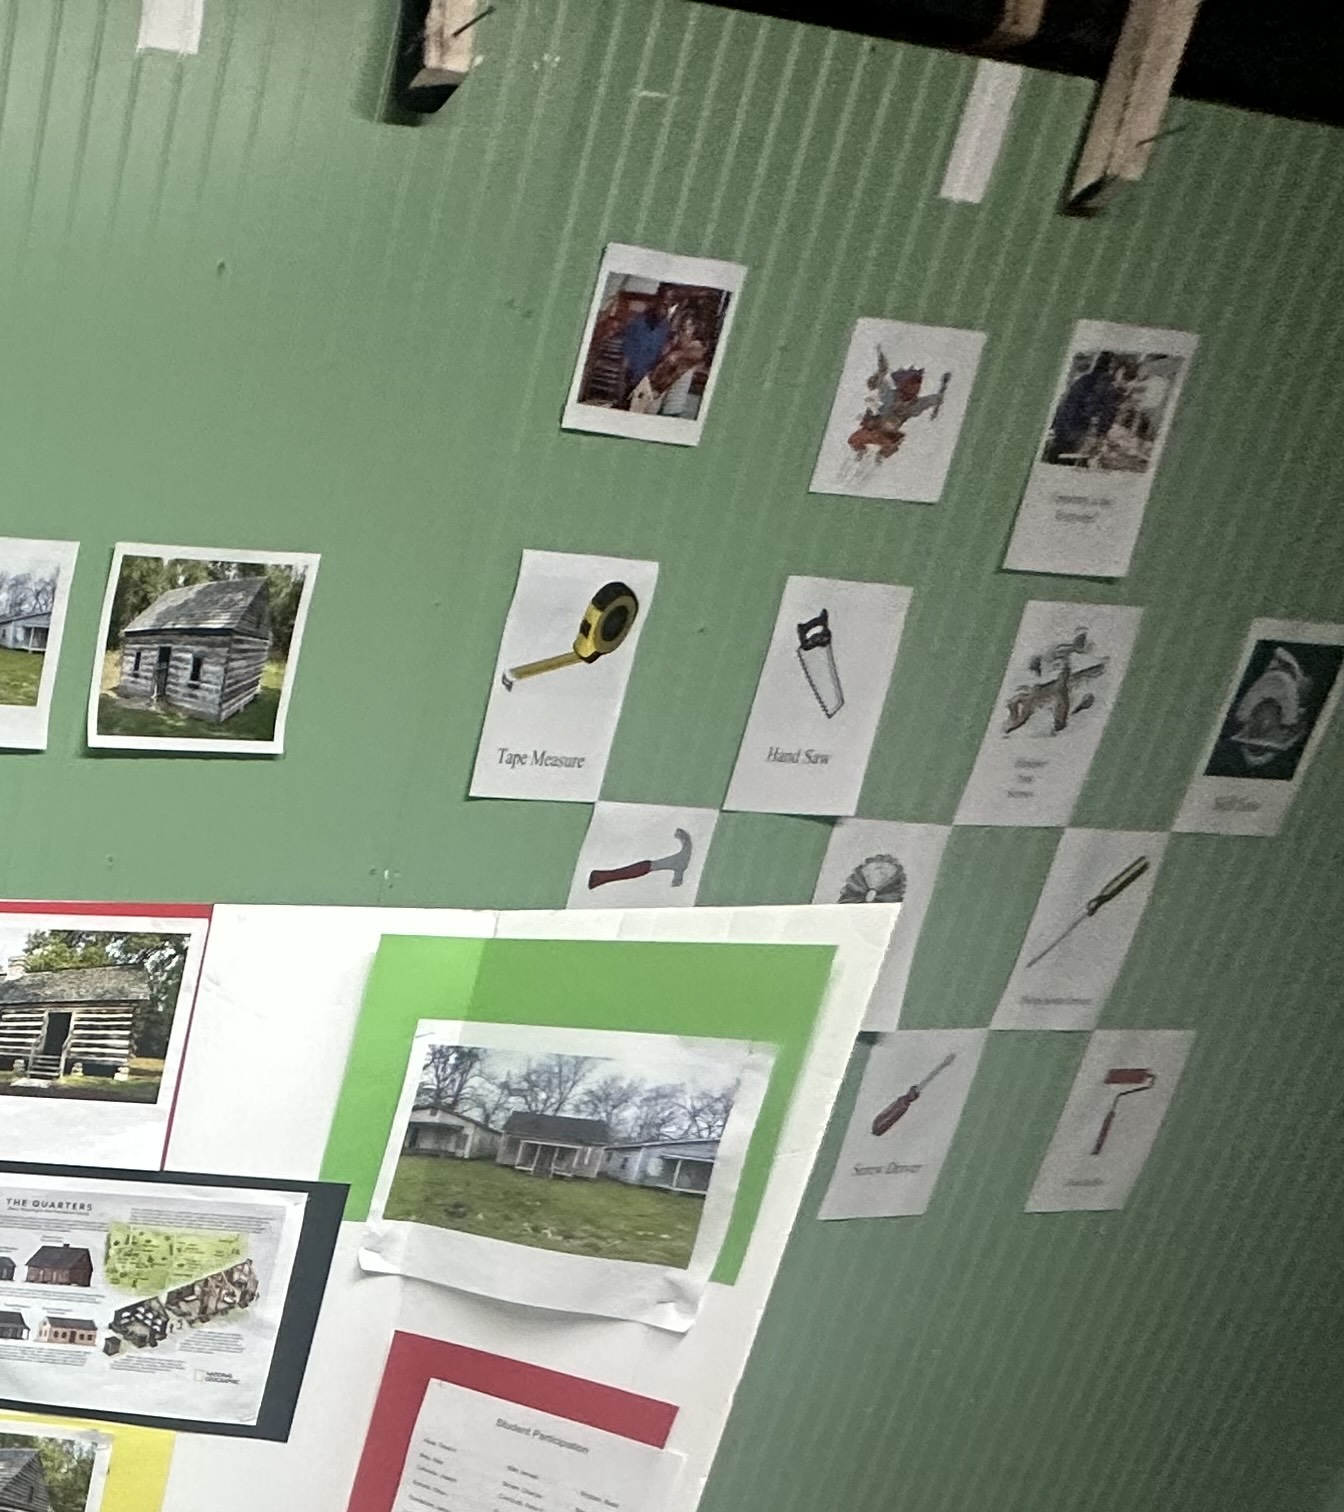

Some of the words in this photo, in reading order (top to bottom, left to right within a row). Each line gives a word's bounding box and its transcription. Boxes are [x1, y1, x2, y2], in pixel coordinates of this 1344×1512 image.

[497, 747, 528, 769] Tape
[530, 749, 585, 769] Measure
[765, 746, 802, 763] Hand
[5, 1197, 29, 1208] THE
[31, 1199, 93, 1212] QUARTERS
[496, 1417, 532, 1437] Student
[532, 1429, 590, 1455] Participation
